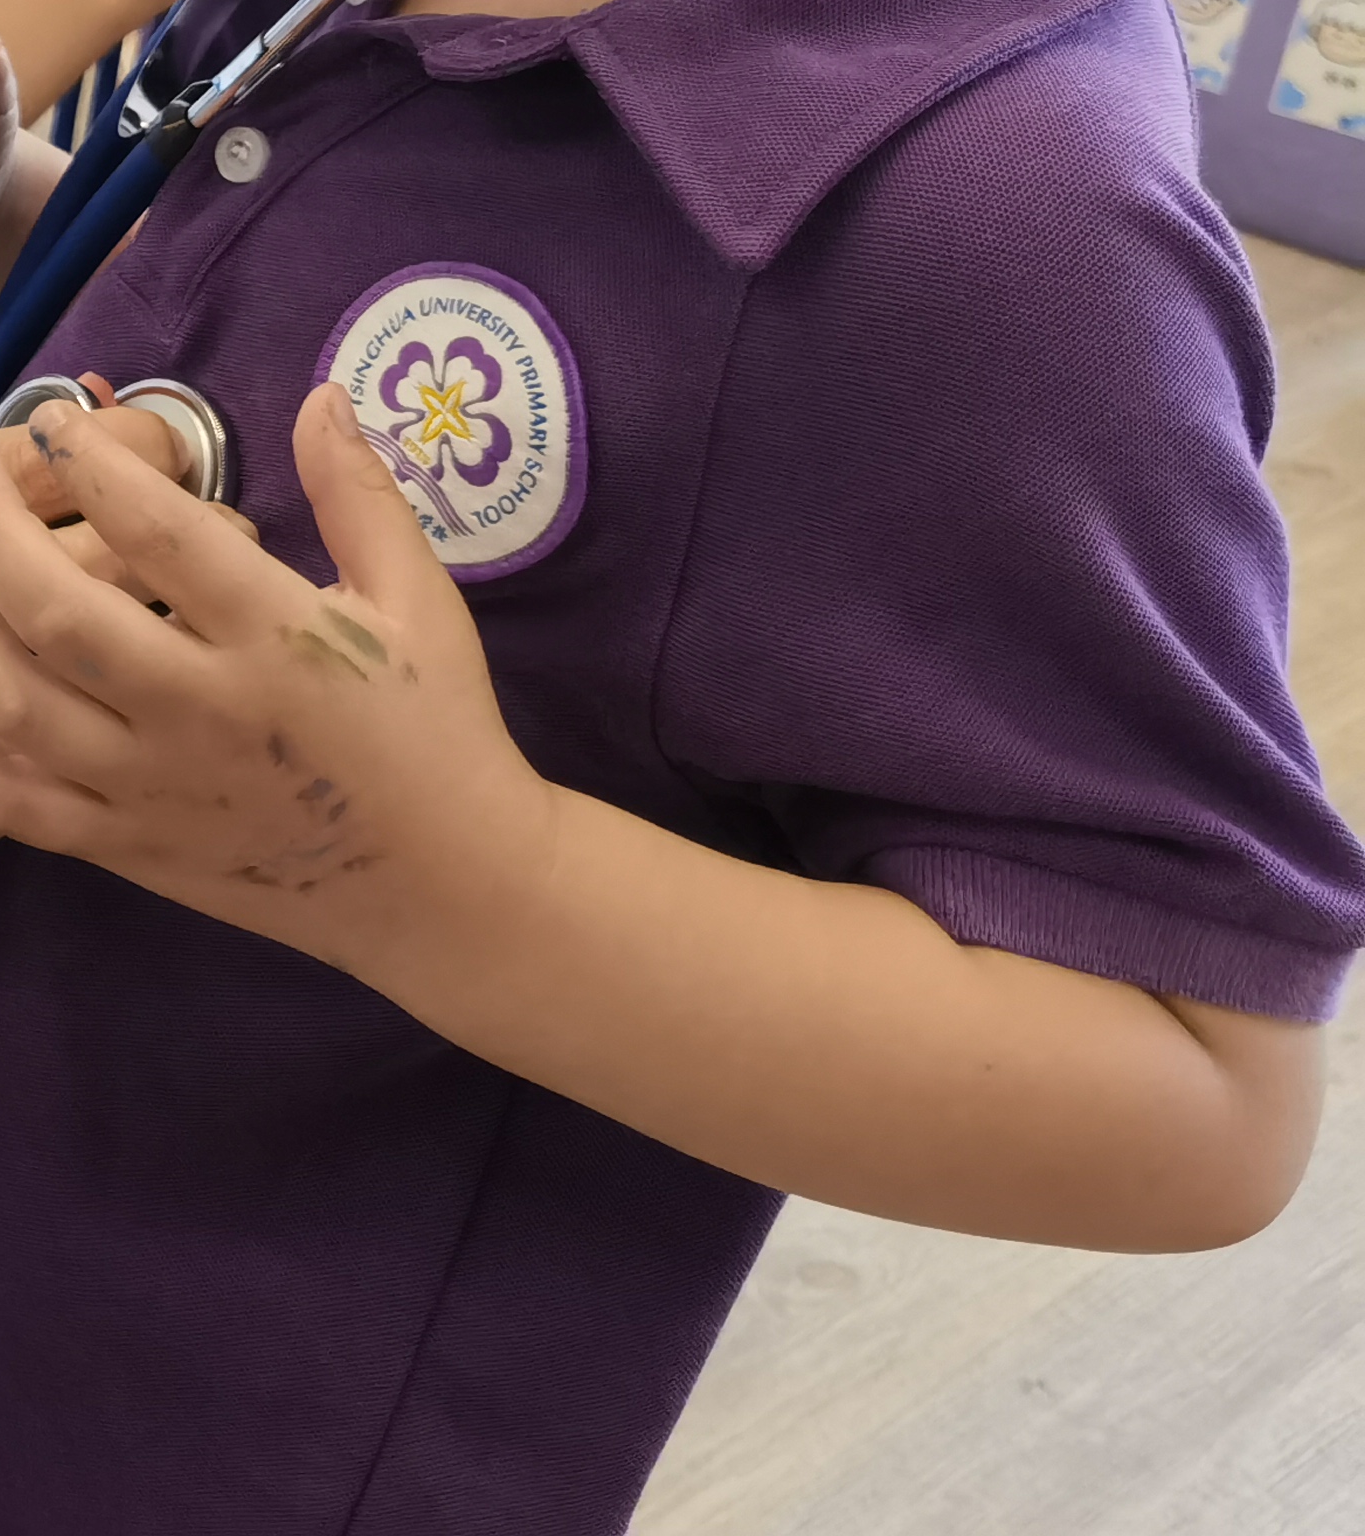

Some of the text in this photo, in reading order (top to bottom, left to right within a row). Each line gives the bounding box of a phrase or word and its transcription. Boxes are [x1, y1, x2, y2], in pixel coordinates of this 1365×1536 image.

[419, 297, 526, 352] UNIVERSITY
[515, 355, 549, 456] PRIMARY
[471, 457, 545, 529] SCHOOL
